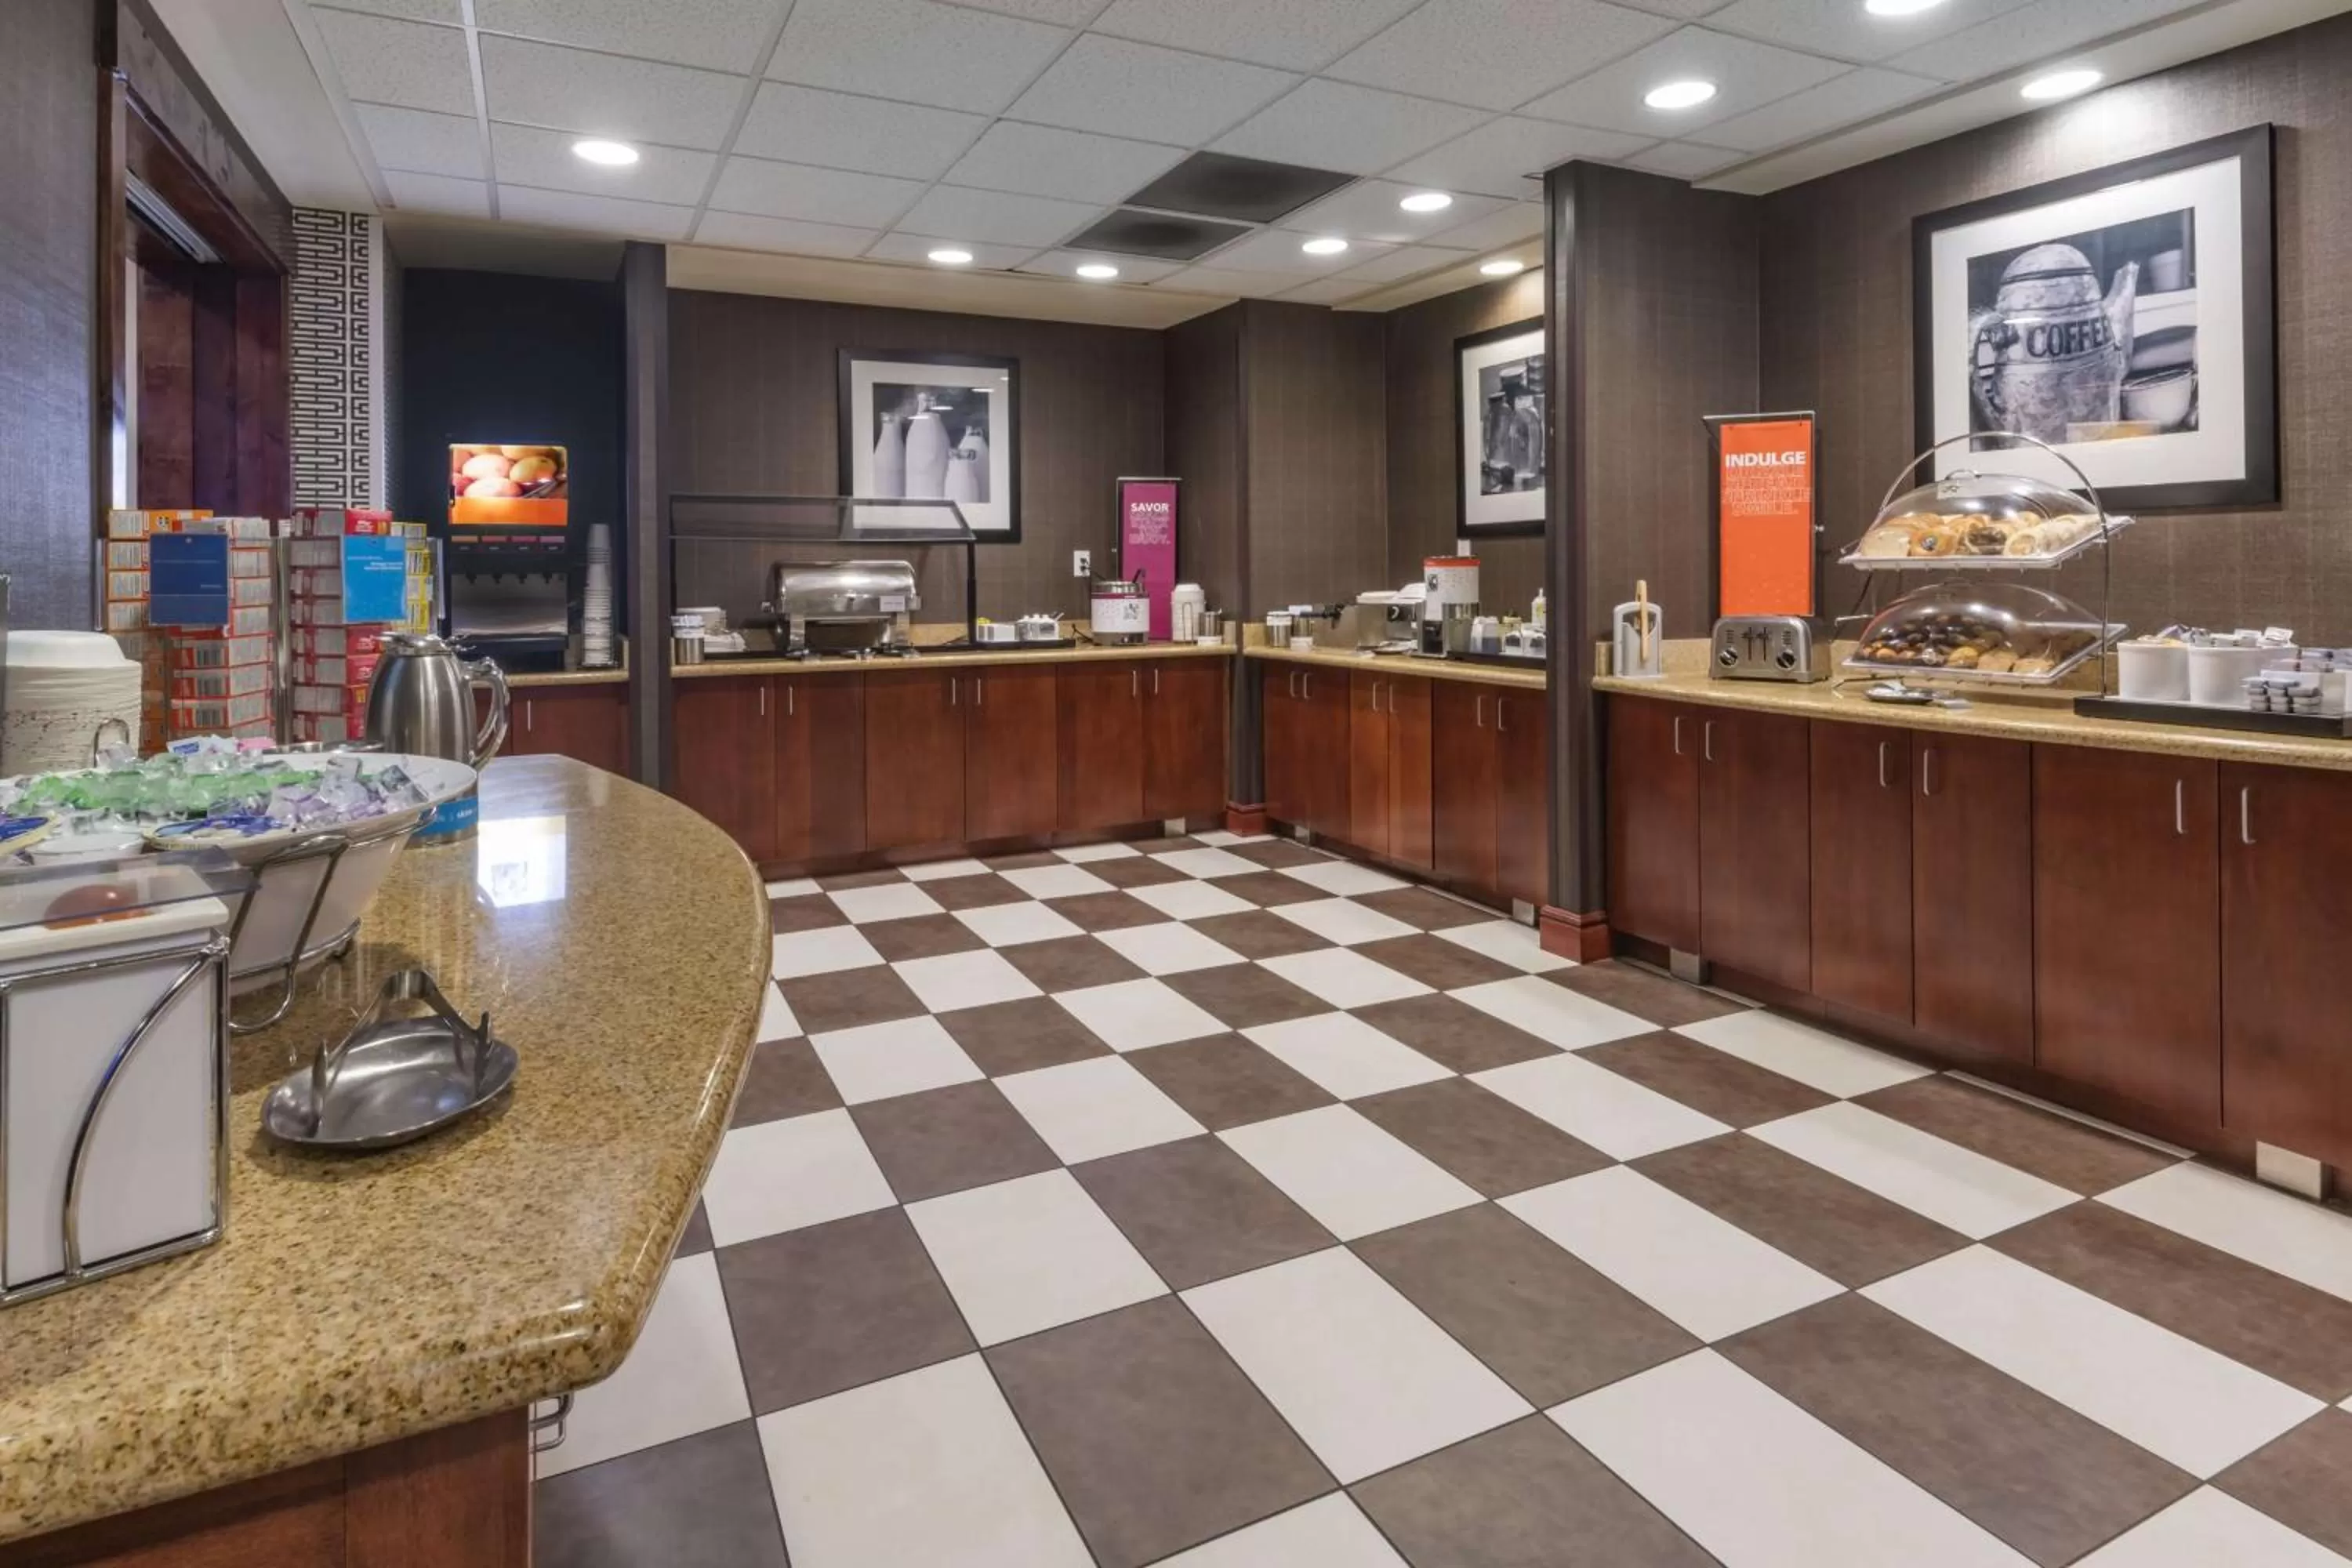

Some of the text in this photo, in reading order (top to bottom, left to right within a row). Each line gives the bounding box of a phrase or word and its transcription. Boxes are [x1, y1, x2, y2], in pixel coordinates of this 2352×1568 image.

[2027, 314, 2111, 358] COFFEE
[1725, 452, 1806, 467] INDULGE
[1131, 503, 1169, 512] SAVOR
